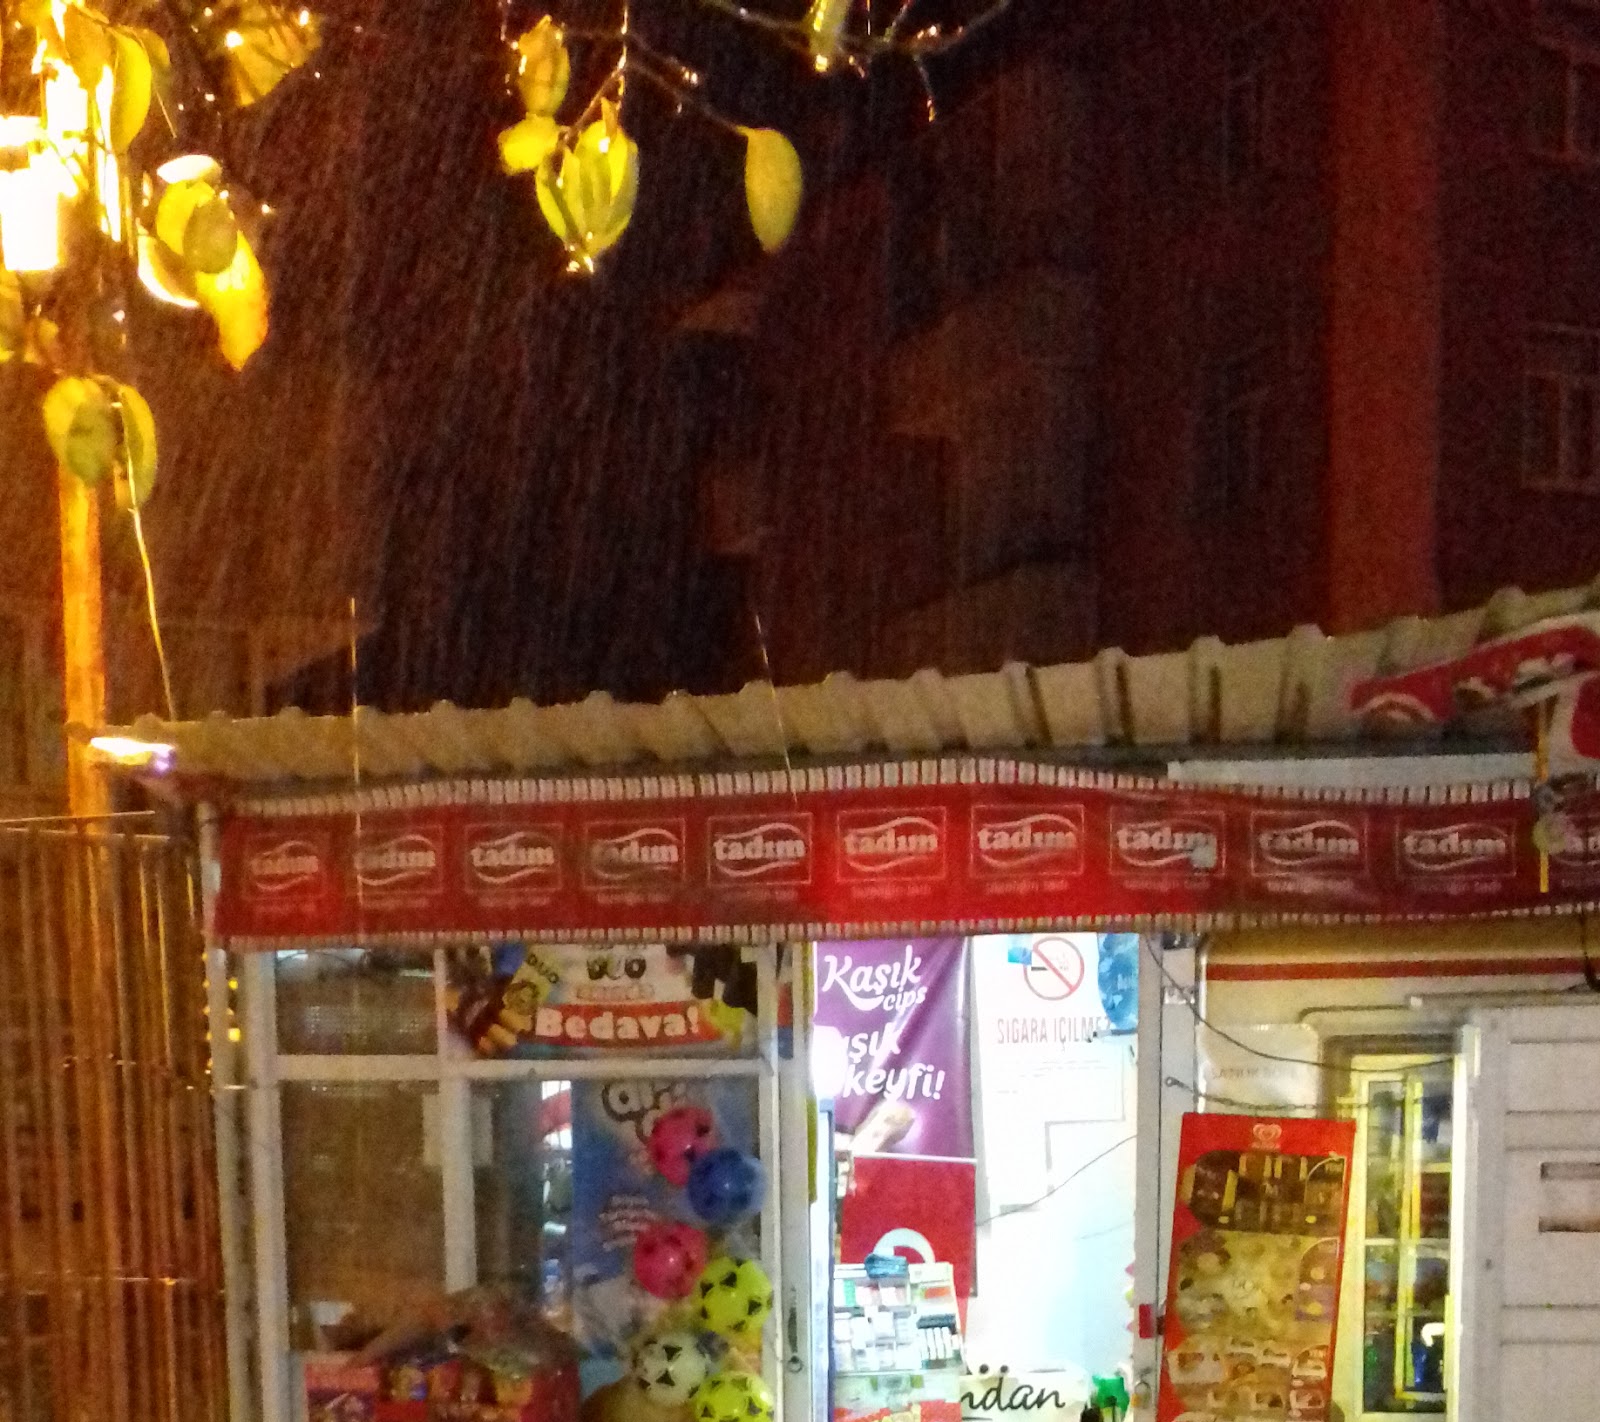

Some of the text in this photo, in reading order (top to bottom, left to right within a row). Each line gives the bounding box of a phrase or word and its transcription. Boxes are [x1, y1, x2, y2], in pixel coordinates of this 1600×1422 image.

[713, 834, 805, 860] tadım
[844, 828, 938, 853] tadım
[977, 824, 1077, 850] tadım
[1116, 826, 1217, 851] tadım
[1259, 831, 1359, 852] tadım
[1403, 831, 1506, 852] tadım
[471, 842, 554, 867] tadım
[822, 945, 922, 1011] Kaşık
[882, 984, 928, 1015] cips
[535, 1007, 700, 1040] Bedava!
[842, 1062, 946, 1101] keyfi!
